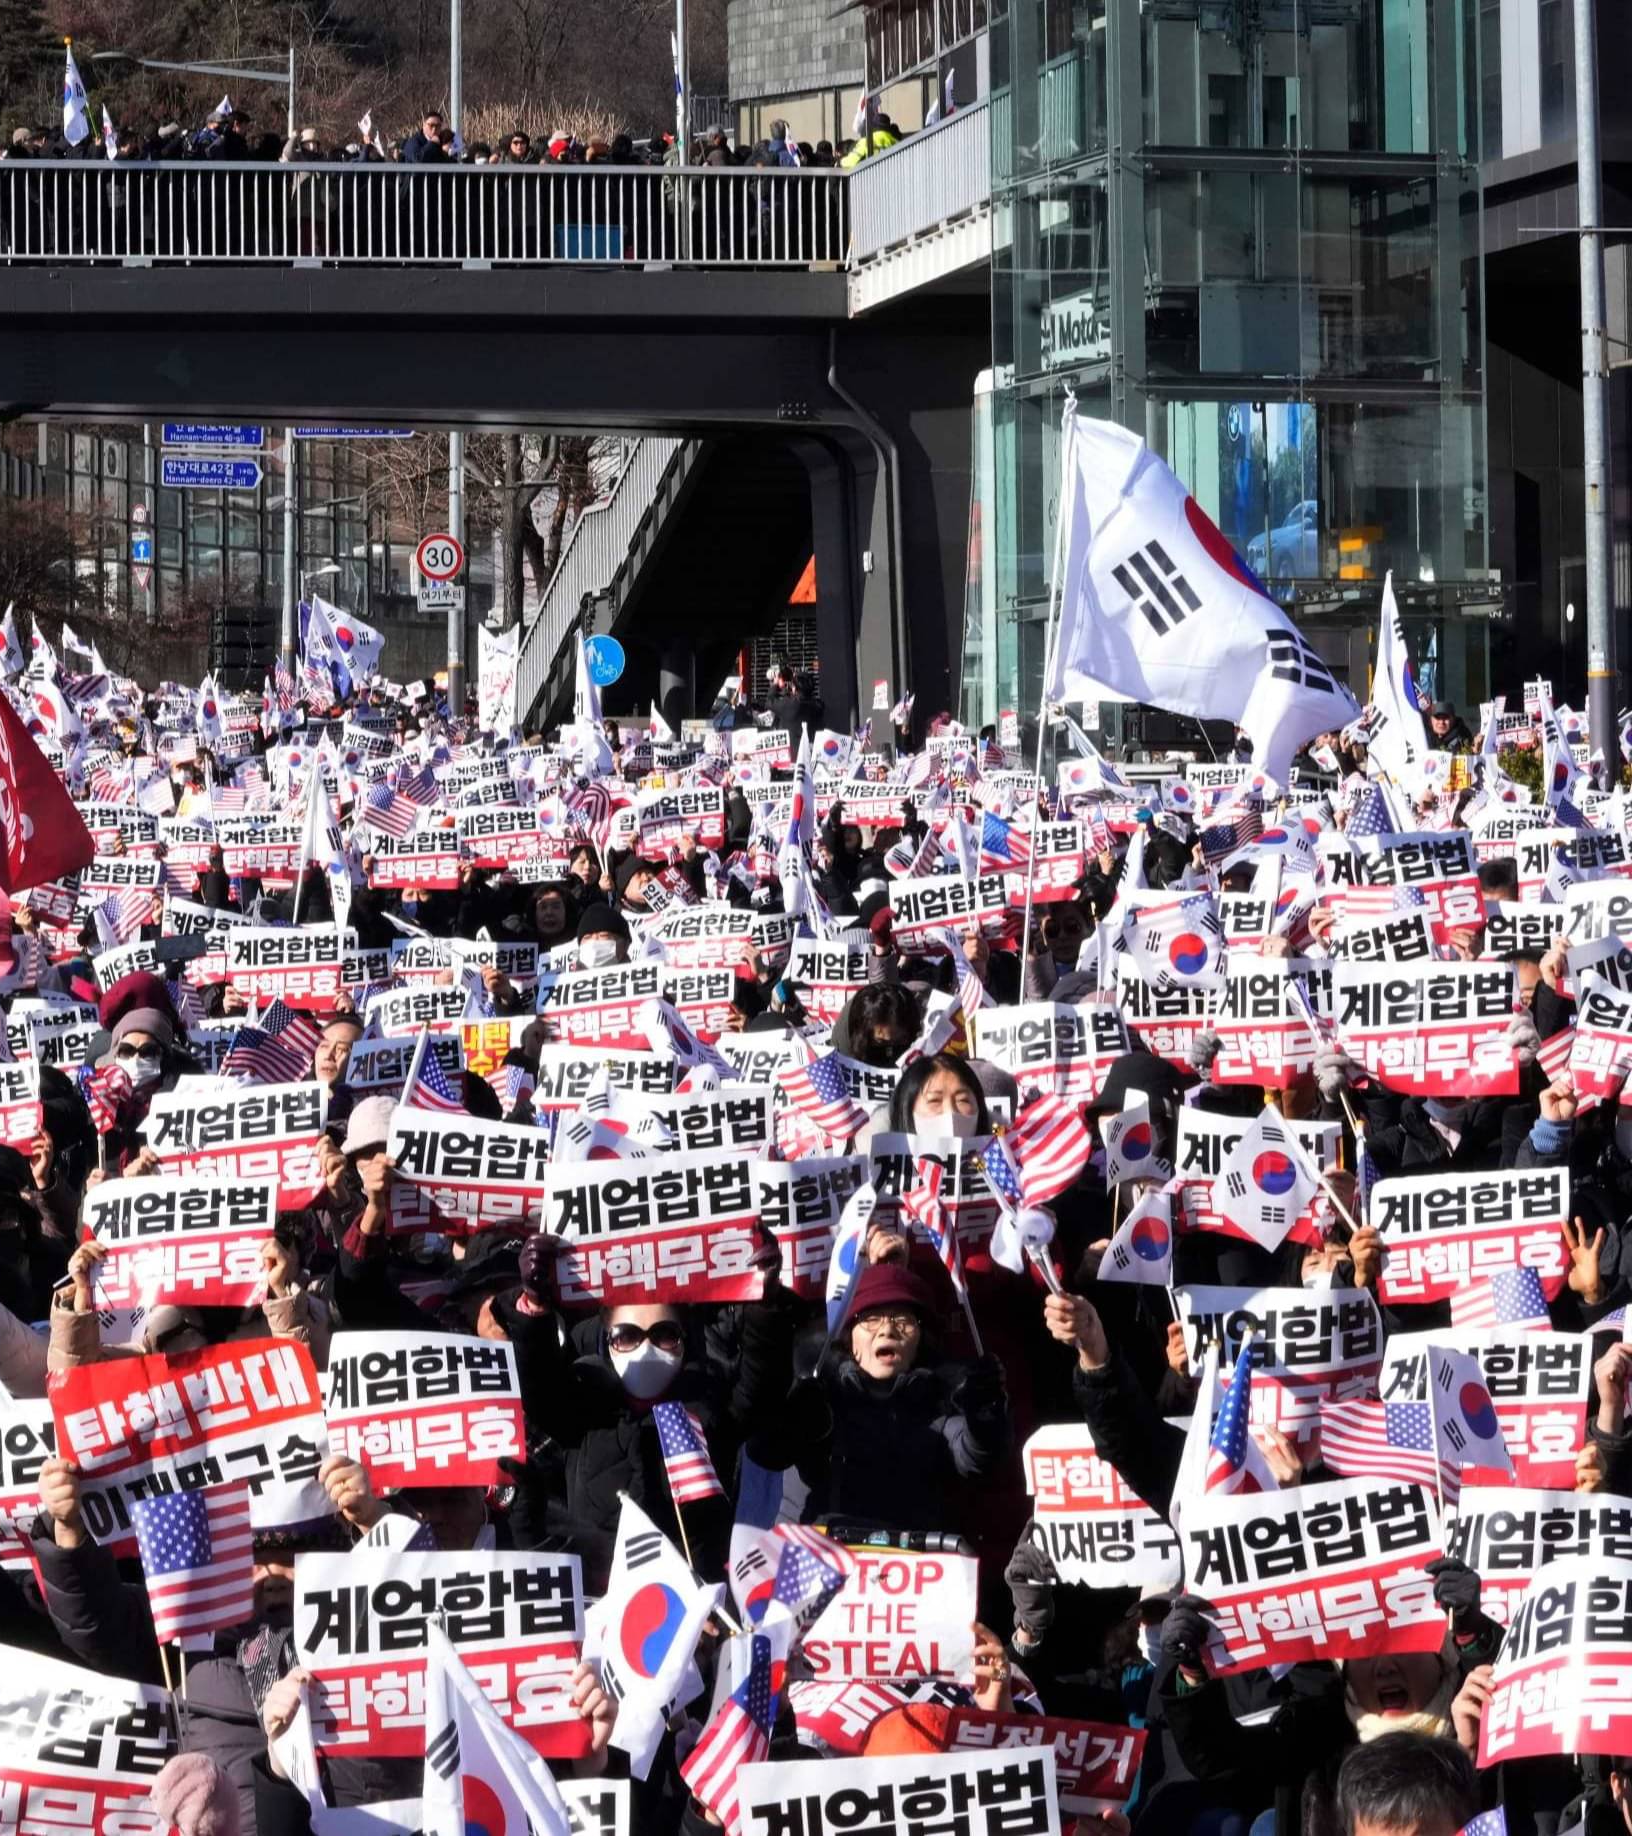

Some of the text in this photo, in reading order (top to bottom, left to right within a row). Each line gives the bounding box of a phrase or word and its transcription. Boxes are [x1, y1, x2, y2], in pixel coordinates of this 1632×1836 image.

[426, 547, 453, 567] 30
[643, 795, 720, 818] 계엄합법
[374, 830, 458, 853] 계엄합법
[1329, 837, 1467, 881] 계엄합법
[372, 860, 459, 884] 탄핵무효
[891, 881, 1006, 921] 계엄합법
[664, 914, 751, 938] 계엄합법
[1331, 915, 1427, 962] 엄합법
[1487, 908, 1561, 950] 엄합
[99, 950, 158, 987] 계엄합
[234, 933, 339, 965] 계엄합법
[798, 953, 869, 983] 계엄합
[238, 971, 336, 1000] 탄핵무효
[543, 966, 659, 1006] 계엄합법
[1341, 972, 1514, 1025] 계엄합법
[1218, 1028, 1316, 1077] 탄핵무
[154, 1090, 320, 1147] 계엄합법
[91, 1189, 269, 1238] 계엄합법
[552, 1161, 751, 1236] 계엄합법
[1378, 1174, 1562, 1233] 계엄합법
[555, 1227, 757, 1298] 탄핵무효
[1381, 1230, 1563, 1296] 탄핵무효
[330, 1344, 509, 1411] 계엄합법
[1383, 1345, 1582, 1401] 계합법
[70, 1345, 311, 1470] 탄핵반대
[330, 1406, 517, 1473] 탄핵무효
[1036, 1453, 1114, 1490] 탄핵
[1030, 1521, 1135, 1563] 이재명
[1190, 1487, 1432, 1586] 계엄합법
[852, 1560, 945, 1595] TOP
[303, 1565, 577, 1655] 계엄합법
[841, 1603, 917, 1634] THE
[1212, 1566, 1447, 1669] 탄핵무효
[803, 1641, 955, 1677] STEAL
